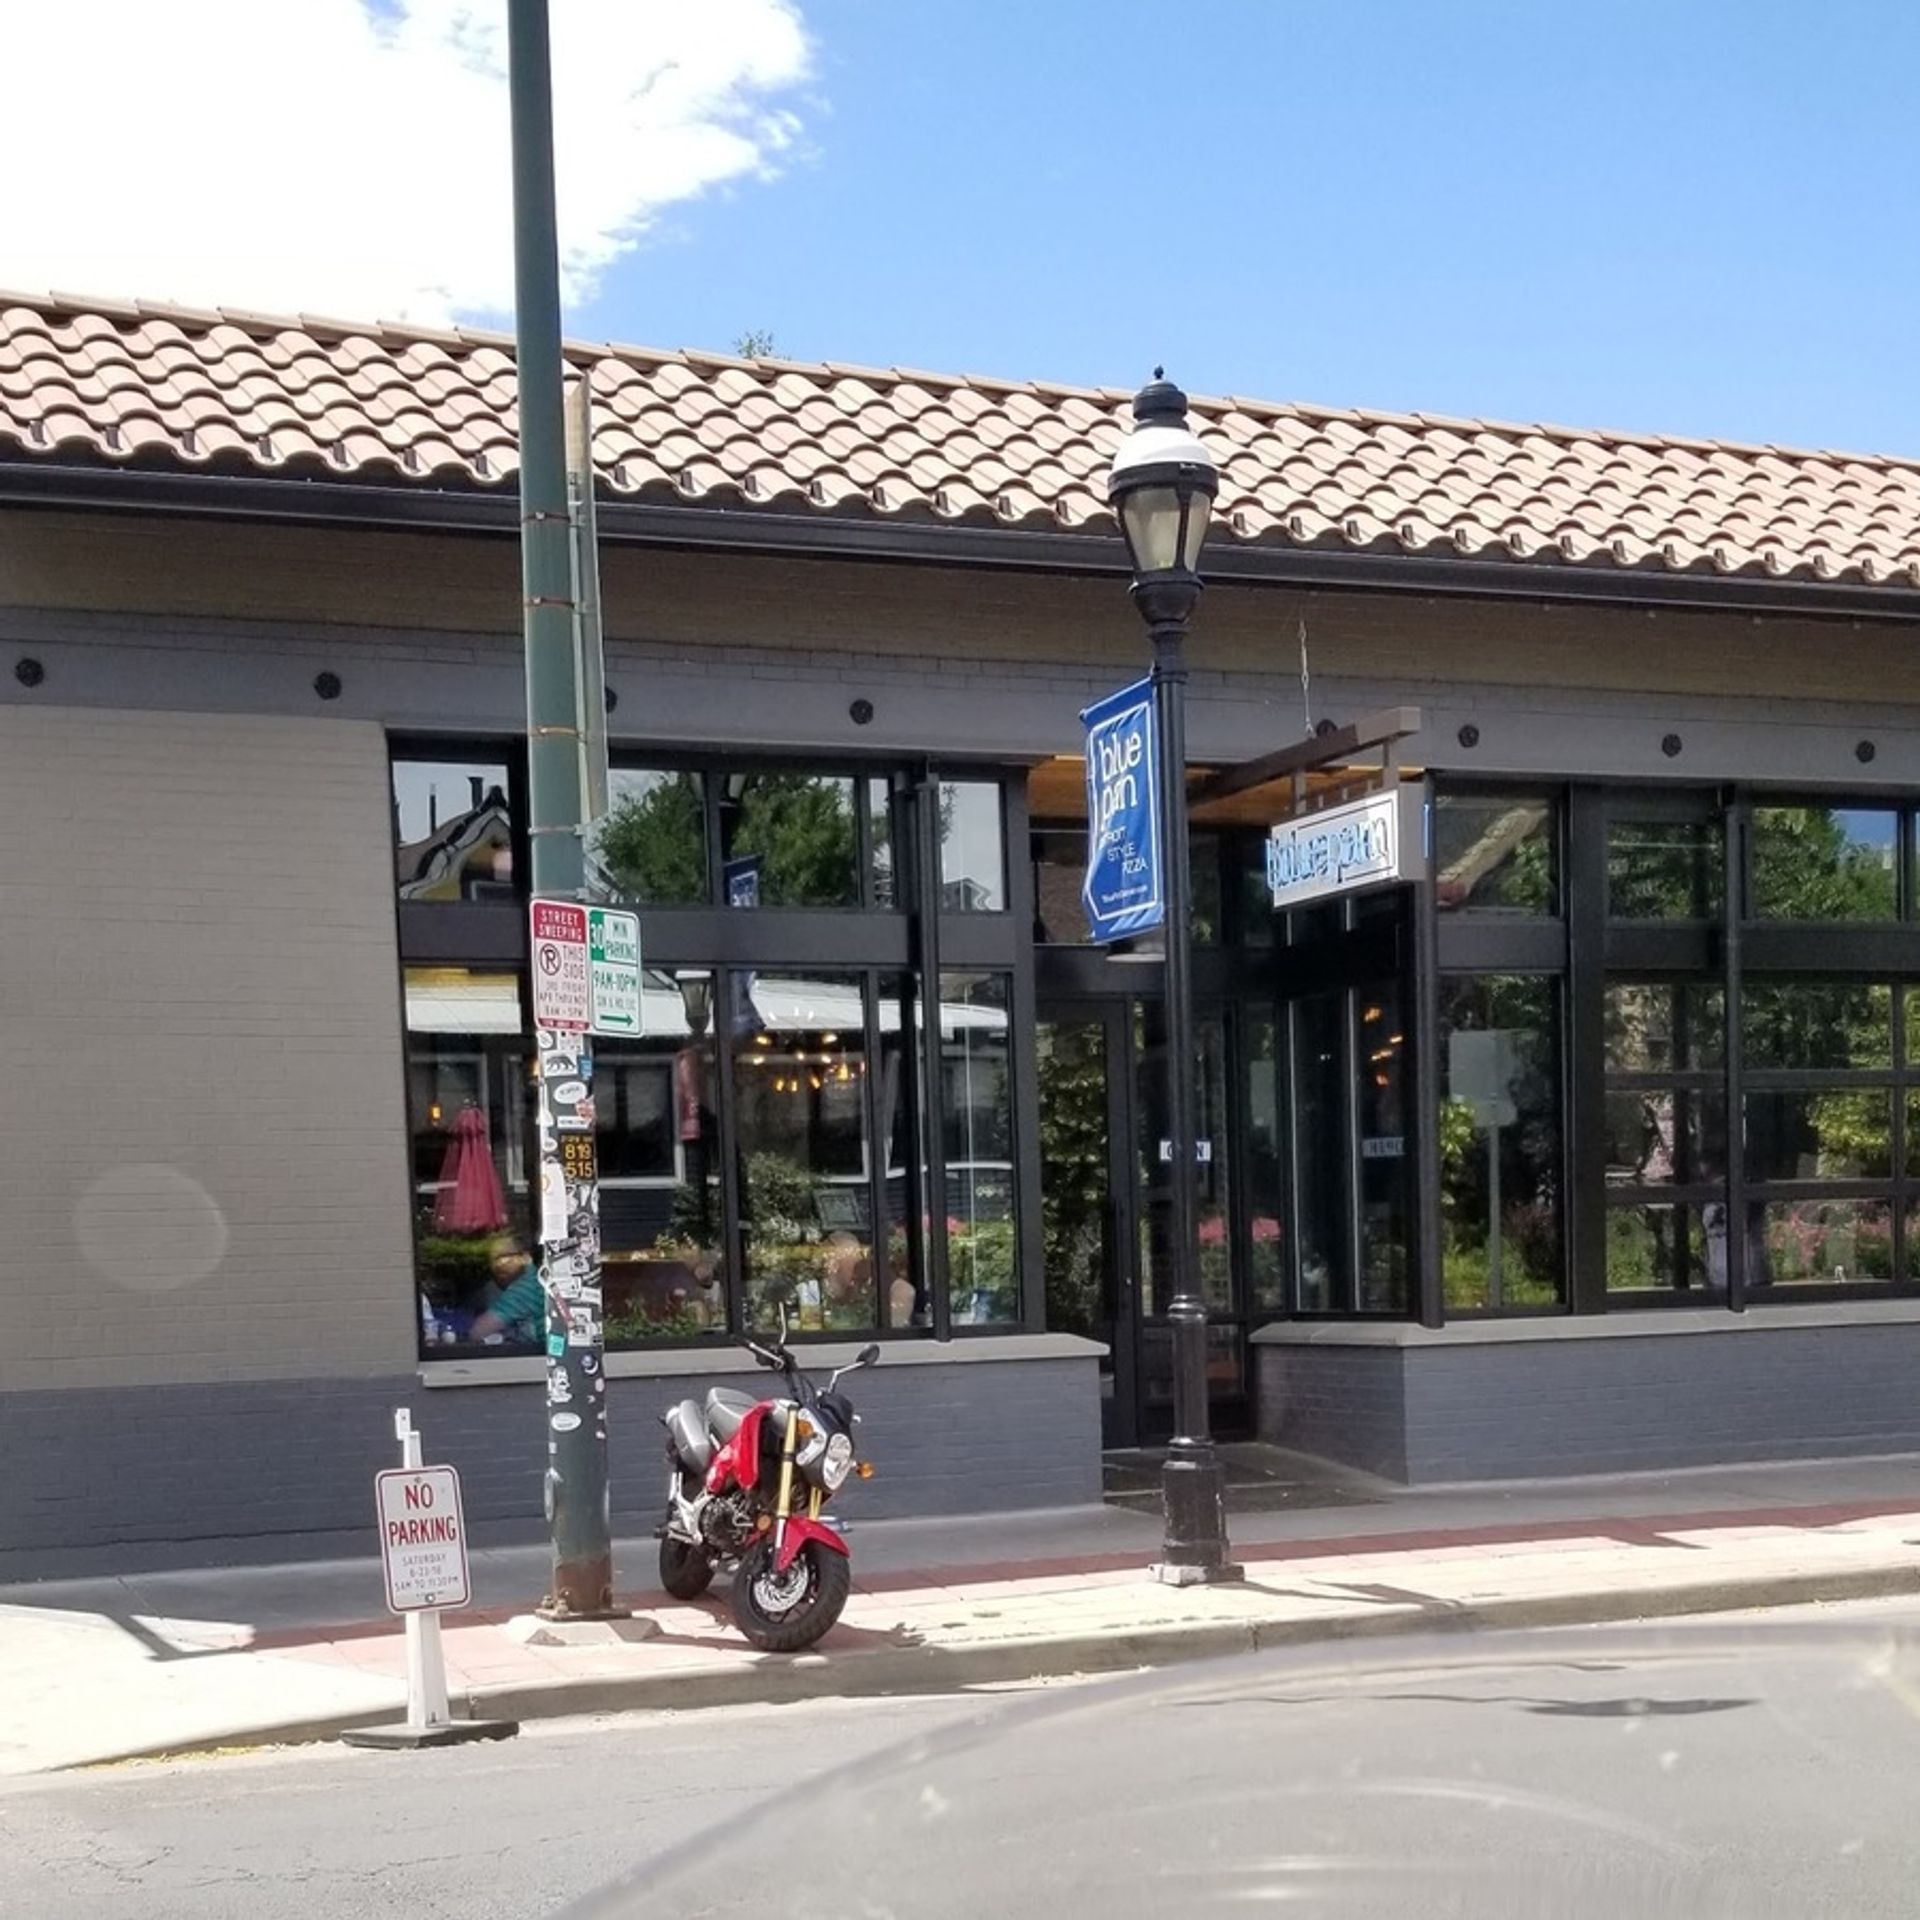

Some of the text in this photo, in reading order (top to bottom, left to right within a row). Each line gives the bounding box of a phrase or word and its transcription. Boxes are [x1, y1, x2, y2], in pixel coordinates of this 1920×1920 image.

[1098, 730, 1142, 783] blue
[1101, 773, 1138, 828] pan
[1107, 842, 1137, 862] STYLE
[1265, 817, 1389, 889] blue pan
[541, 909, 579, 926] STREET
[538, 923, 582, 941] SWEEPING
[590, 923, 603, 950] 30
[612, 921, 628, 939] MIN
[562, 944, 584, 963] THIS
[605, 939, 637, 962] PARKING
[563, 963, 585, 980] SIDE
[404, 1483, 434, 1510] NO
[388, 1516, 457, 1548] PARKING
[401, 1552, 447, 1568] SATURDAY
